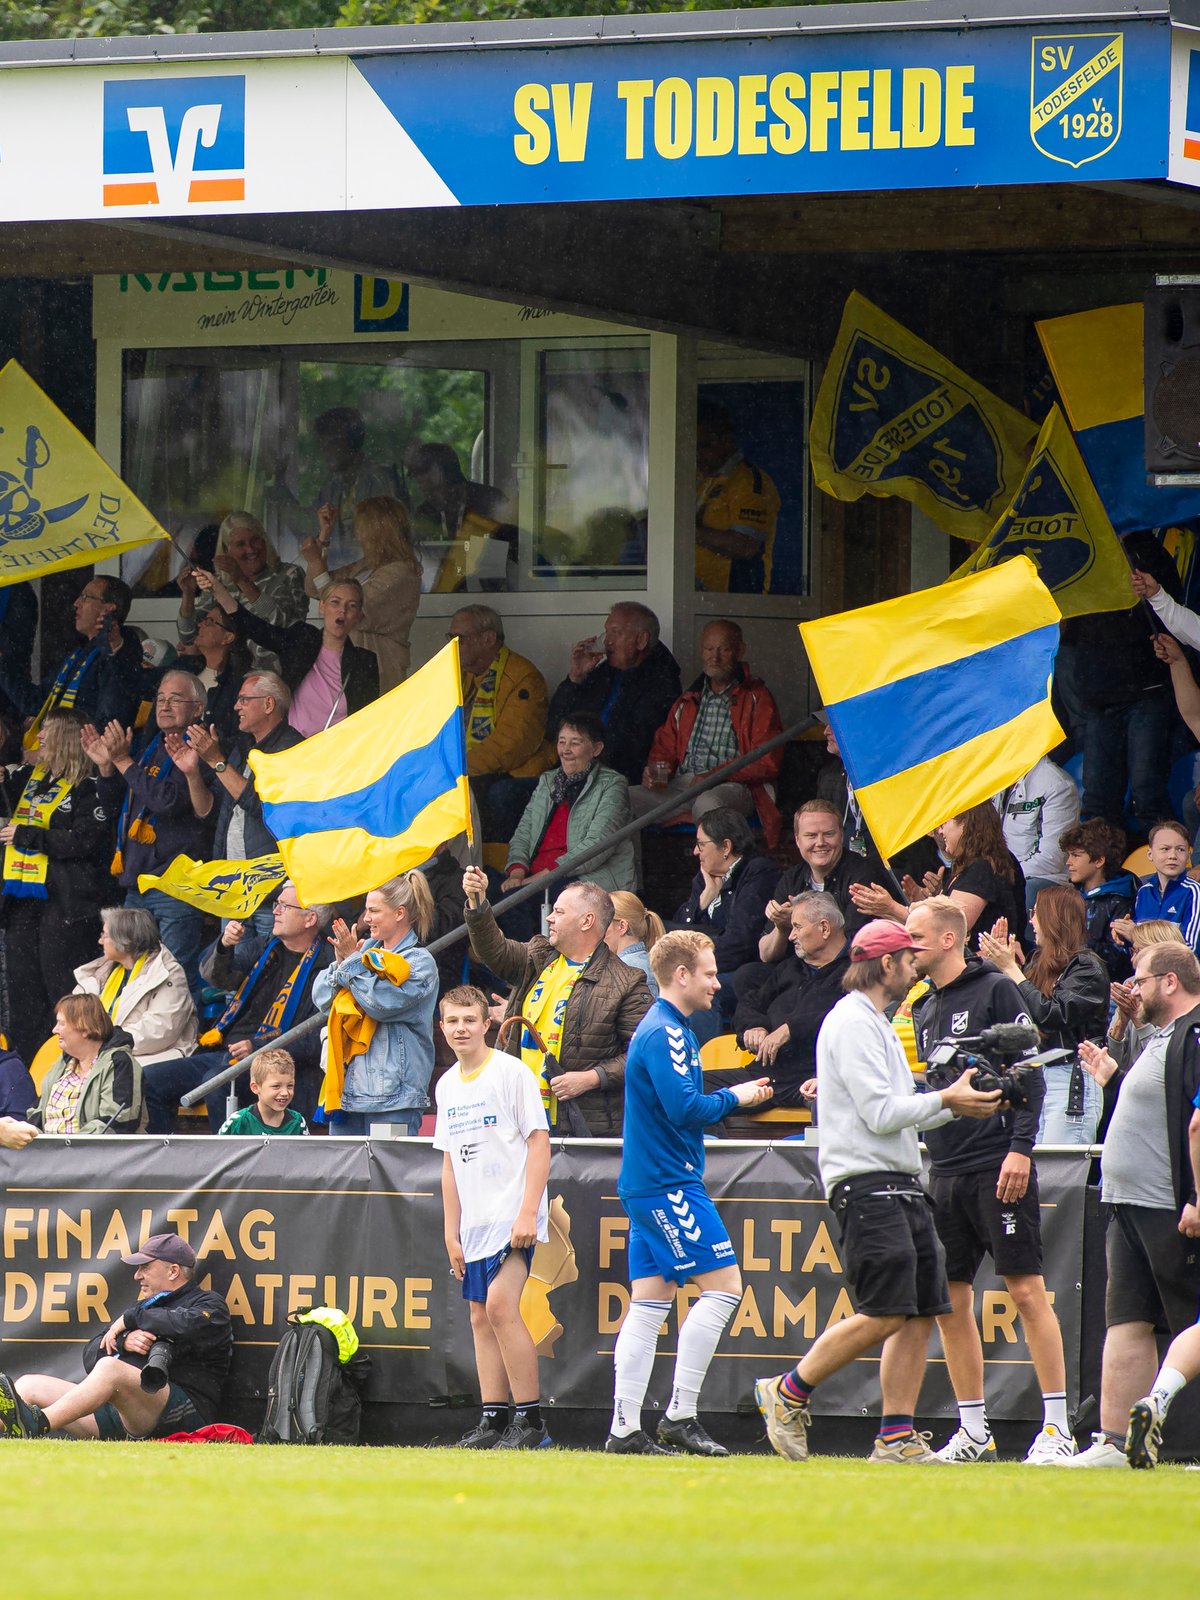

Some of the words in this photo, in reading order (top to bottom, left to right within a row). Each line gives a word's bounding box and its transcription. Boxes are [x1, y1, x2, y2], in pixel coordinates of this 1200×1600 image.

[1034, 47, 1118, 121] TODESFELDE
[1040, 45, 1075, 72] SV
[513, 82, 593, 166] SV
[617, 65, 976, 160] TODESFELDE
[1058, 112, 1113, 139] 1928
[198, 306, 237, 330] mein
[238, 282, 340, 326] Wintergarten
[3, 1271, 112, 1323] DER
[137, 1273, 433, 1329] ATEURE
